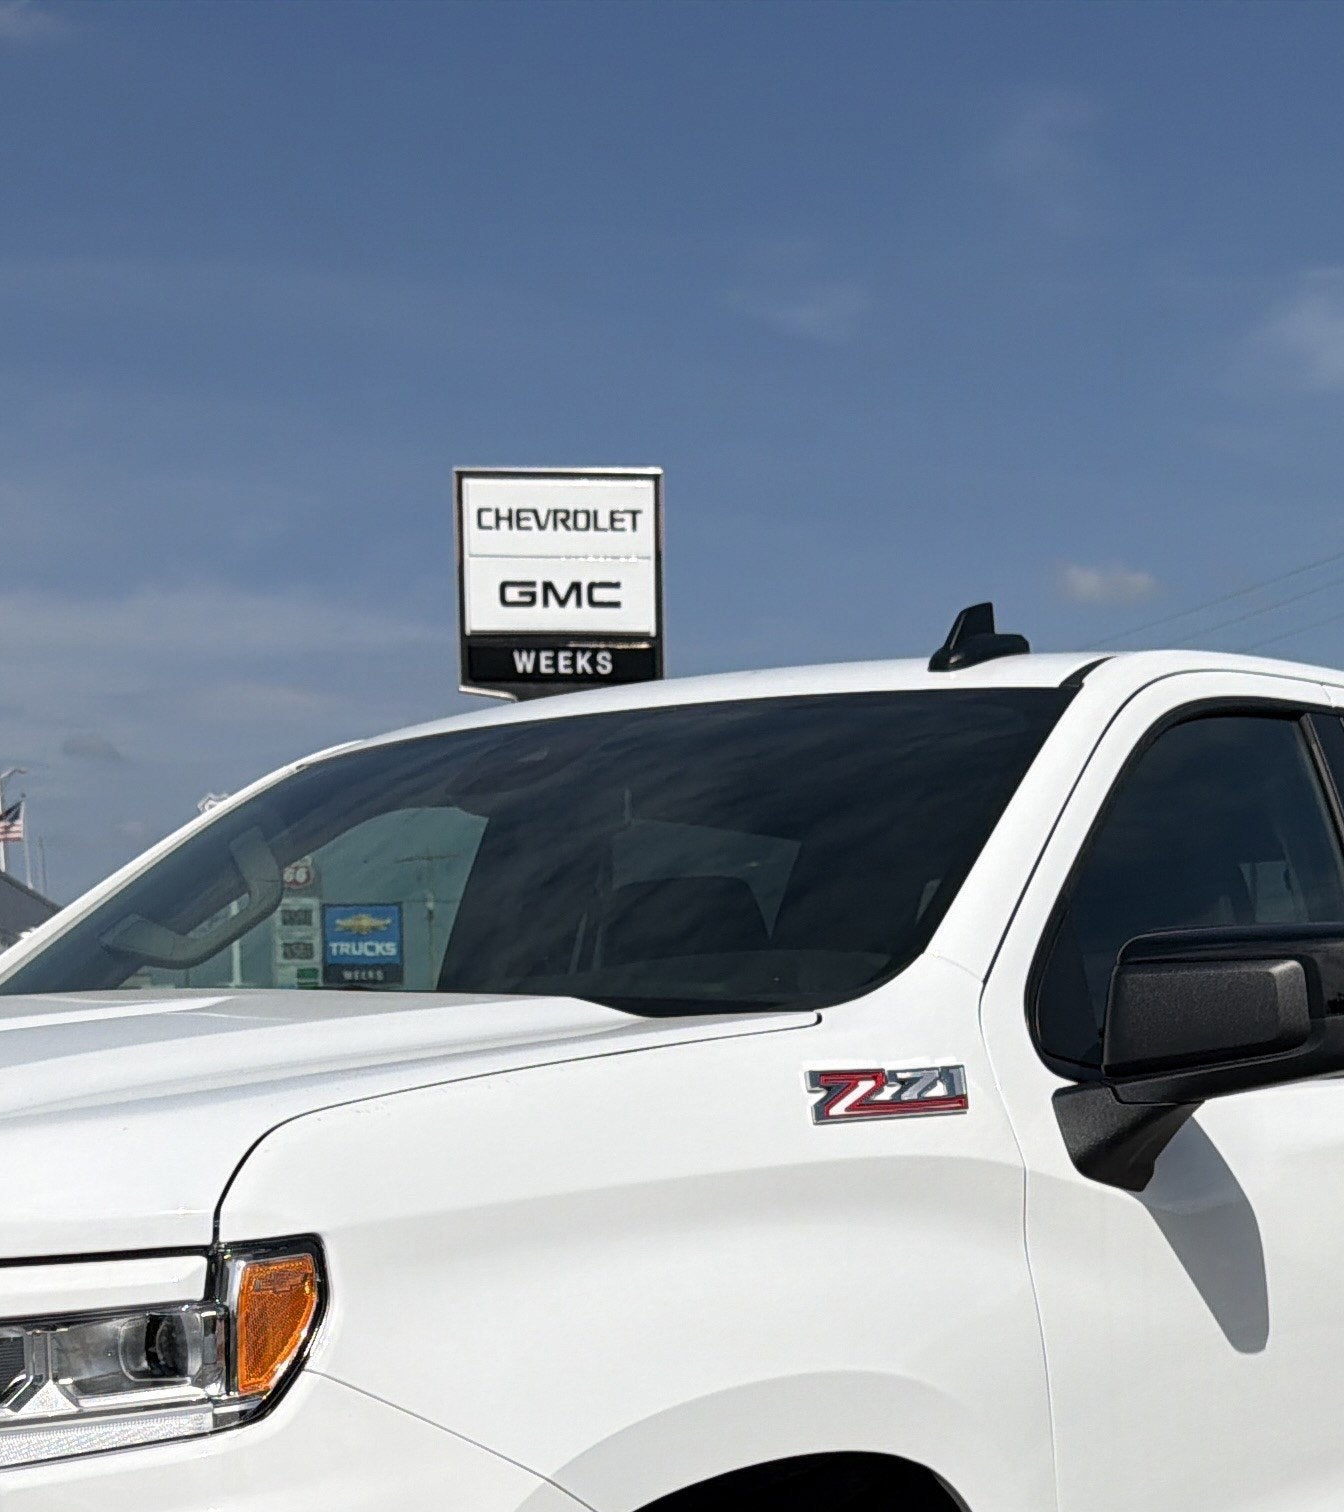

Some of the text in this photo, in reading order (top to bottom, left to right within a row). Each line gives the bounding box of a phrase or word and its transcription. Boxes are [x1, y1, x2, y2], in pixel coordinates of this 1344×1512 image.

[476, 507, 642, 533] CHEVROLET
[499, 580, 622, 609] GMC
[512, 648, 614, 675] WEEKS
[329, 942, 397, 956] TRUCKS
[804, 1064, 969, 1125] Z71
